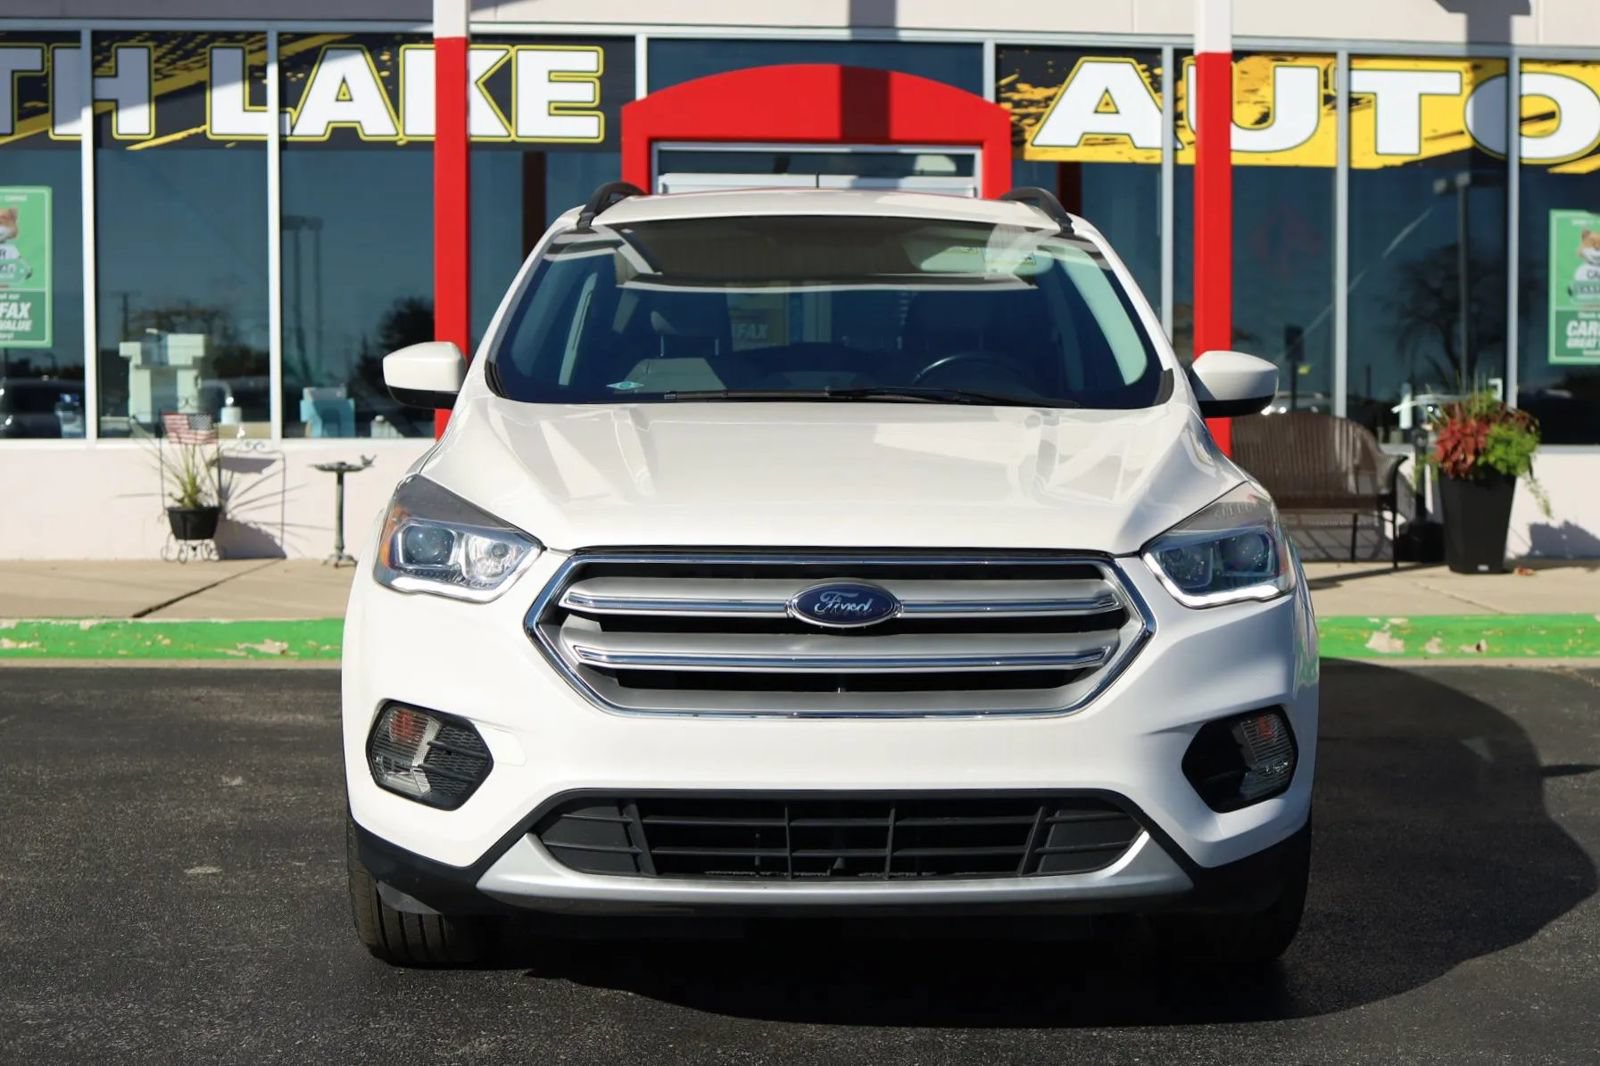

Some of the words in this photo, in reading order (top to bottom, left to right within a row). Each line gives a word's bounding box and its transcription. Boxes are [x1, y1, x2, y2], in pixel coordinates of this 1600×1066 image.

[207, 44, 603, 141] LAKE
[1031, 57, 1600, 164] AUTO
[814, 590, 873, 615] Ford
